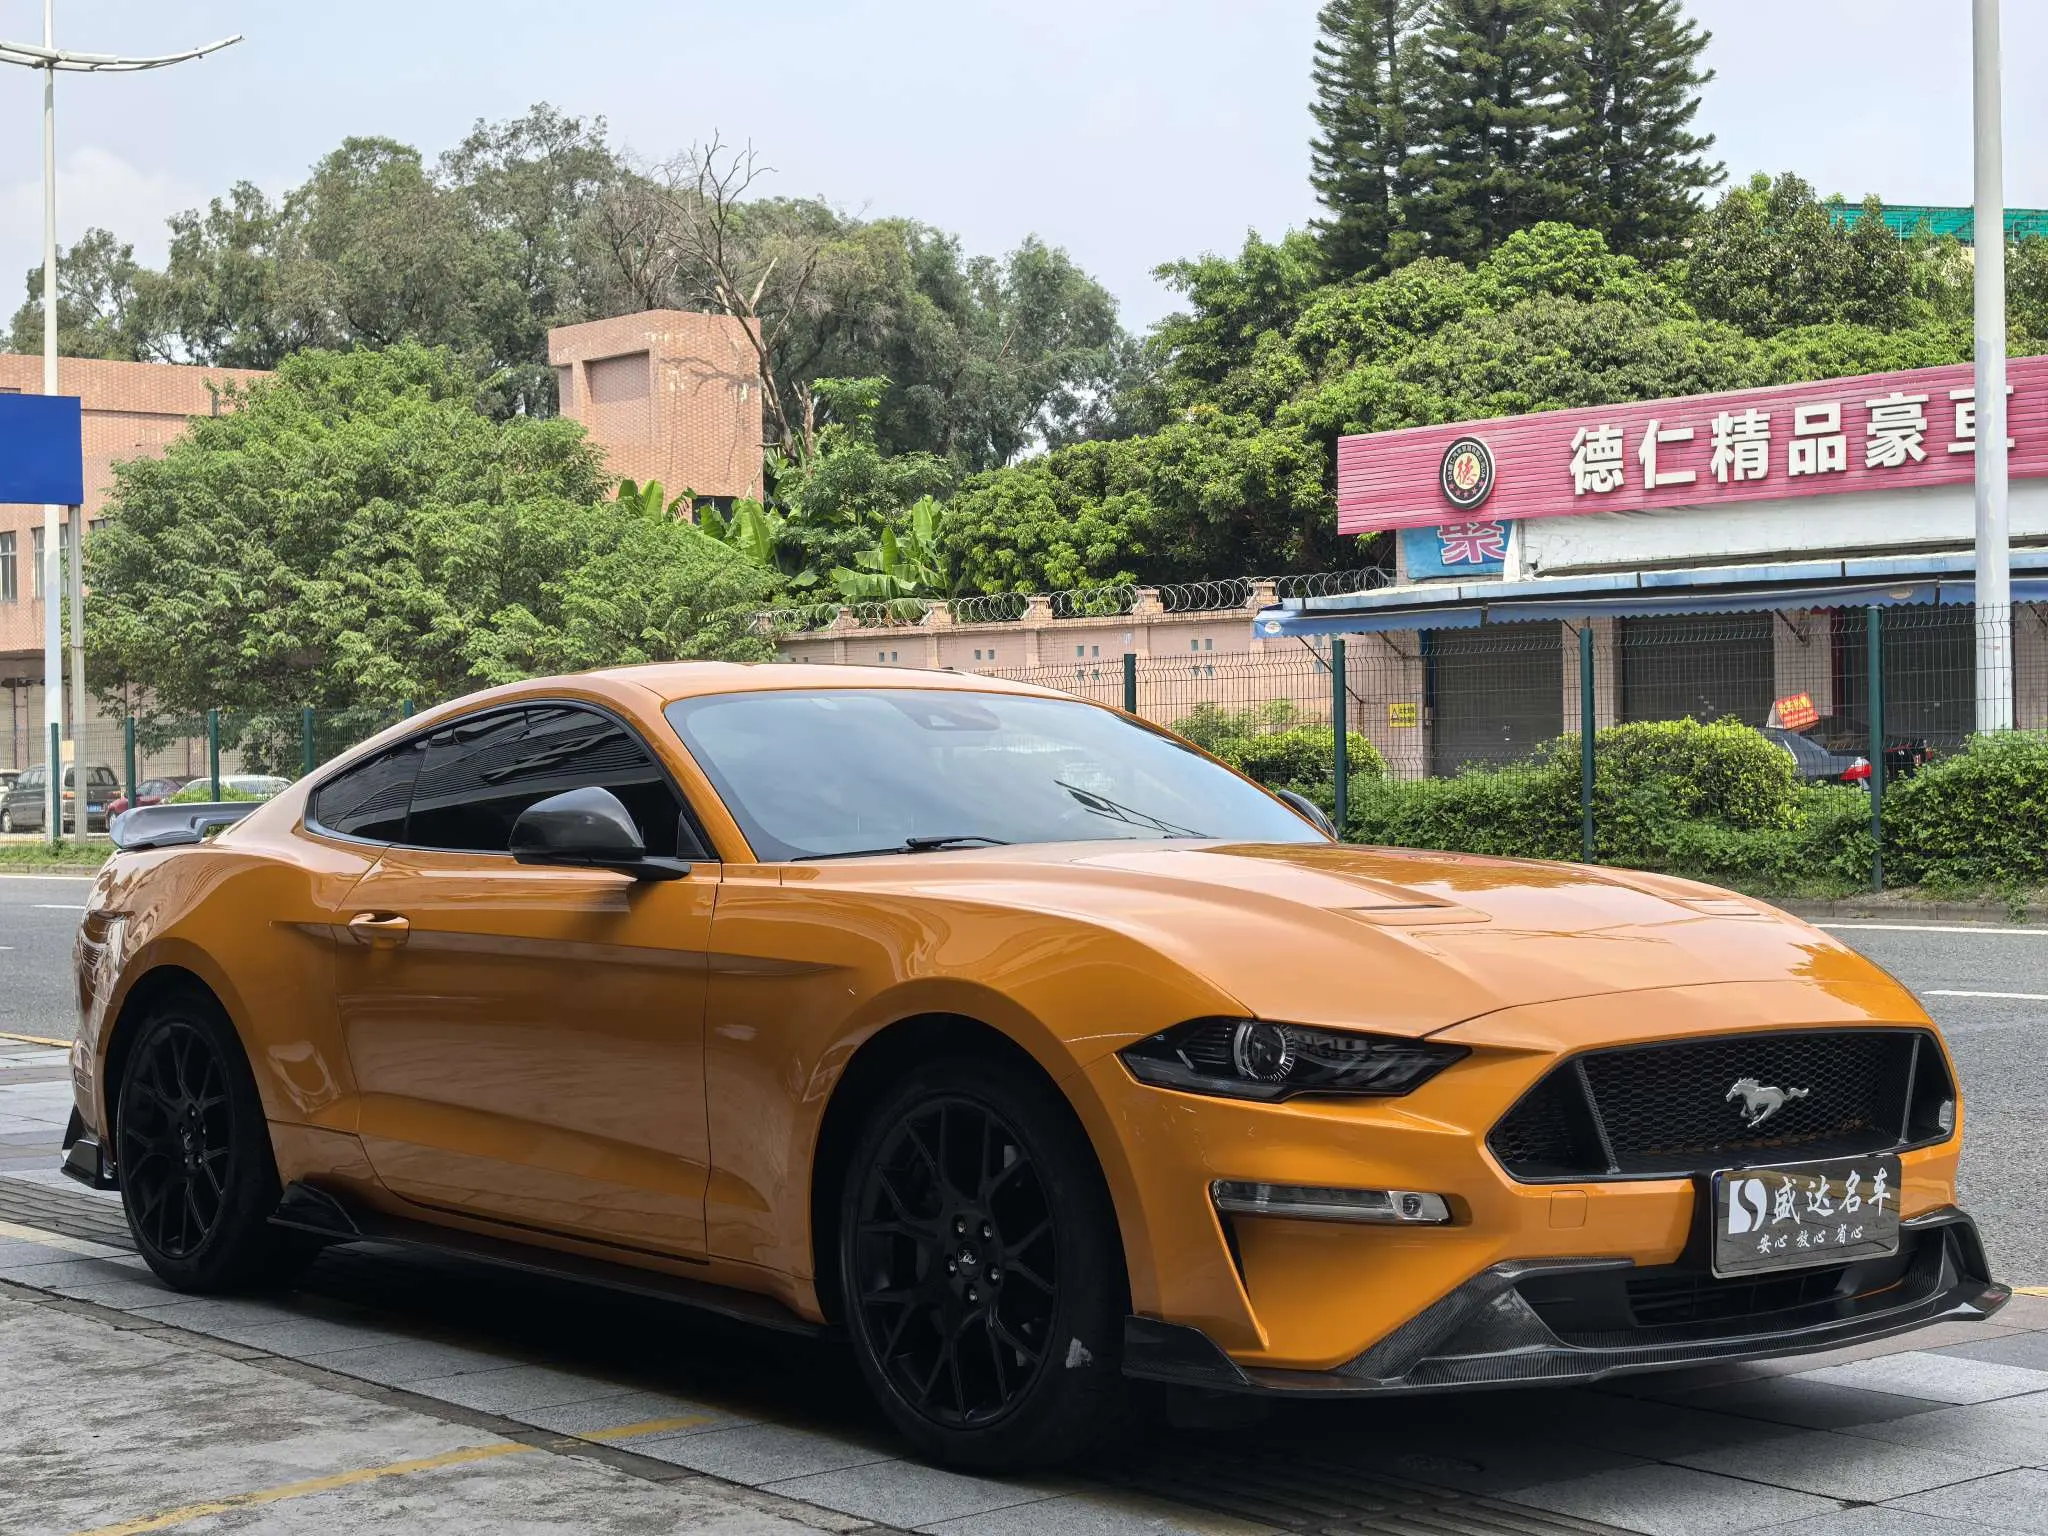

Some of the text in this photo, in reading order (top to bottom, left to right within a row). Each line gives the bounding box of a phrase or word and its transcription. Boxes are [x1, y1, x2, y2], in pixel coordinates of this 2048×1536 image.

[1772, 1167, 1891, 1225] 盛达名车
[1756, 1234, 1788, 1254] 安心
[1835, 1224, 1864, 1245] 省心
